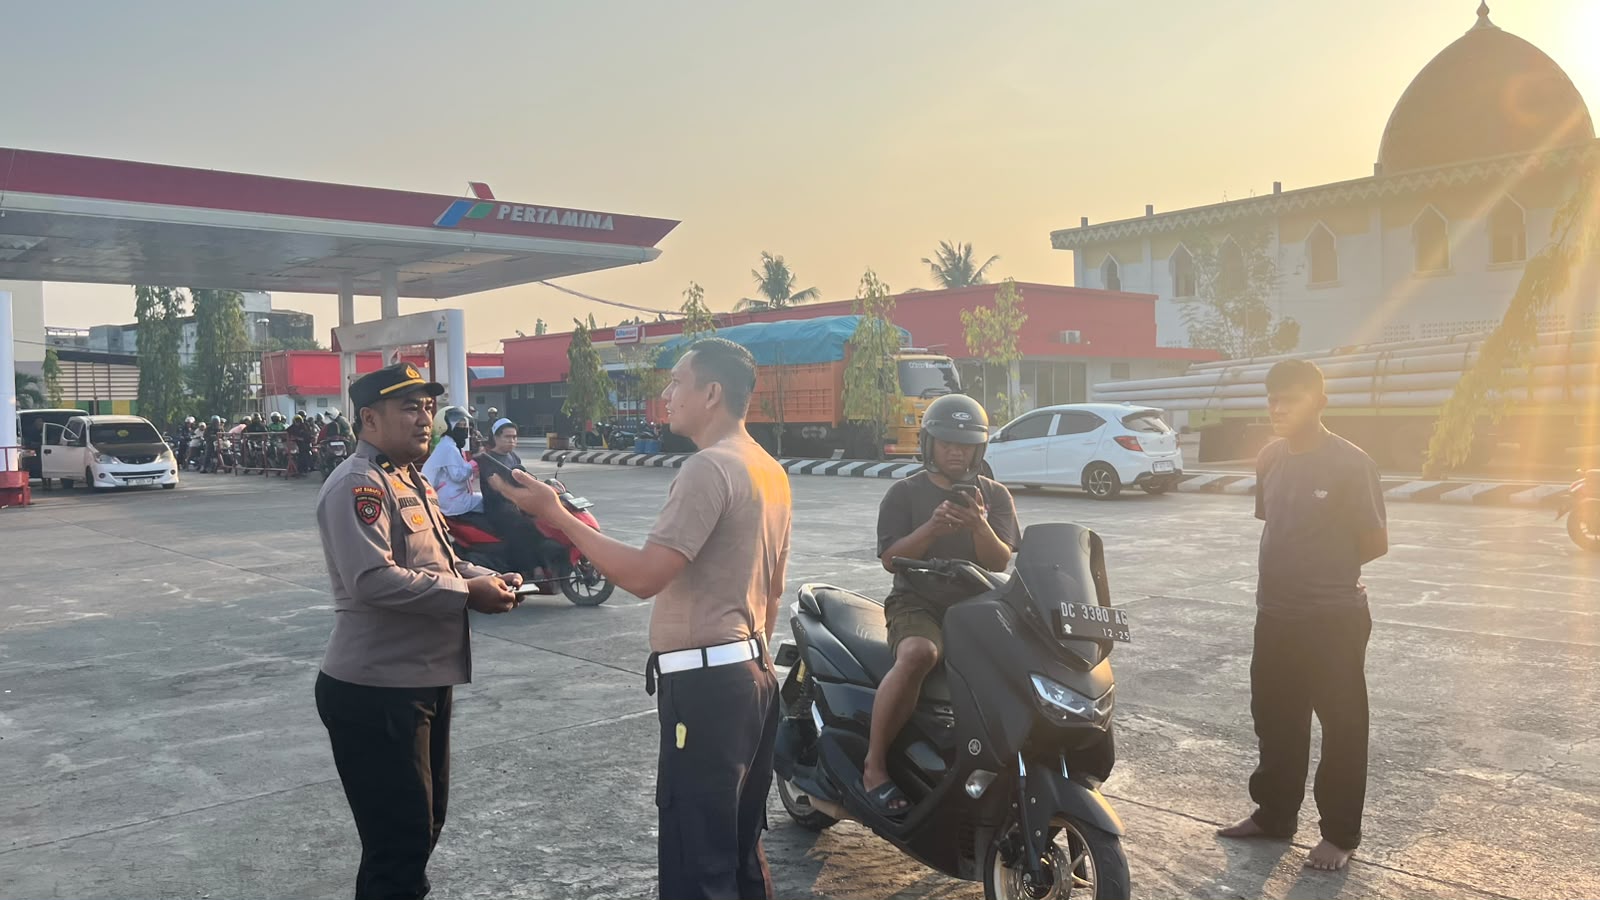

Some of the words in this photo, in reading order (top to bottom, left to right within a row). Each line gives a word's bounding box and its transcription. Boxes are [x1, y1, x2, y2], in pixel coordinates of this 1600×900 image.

[496, 204, 614, 231] PERTAMINA
[1061, 602, 1075, 617] DC
[1081, 605, 1110, 622] 3380
